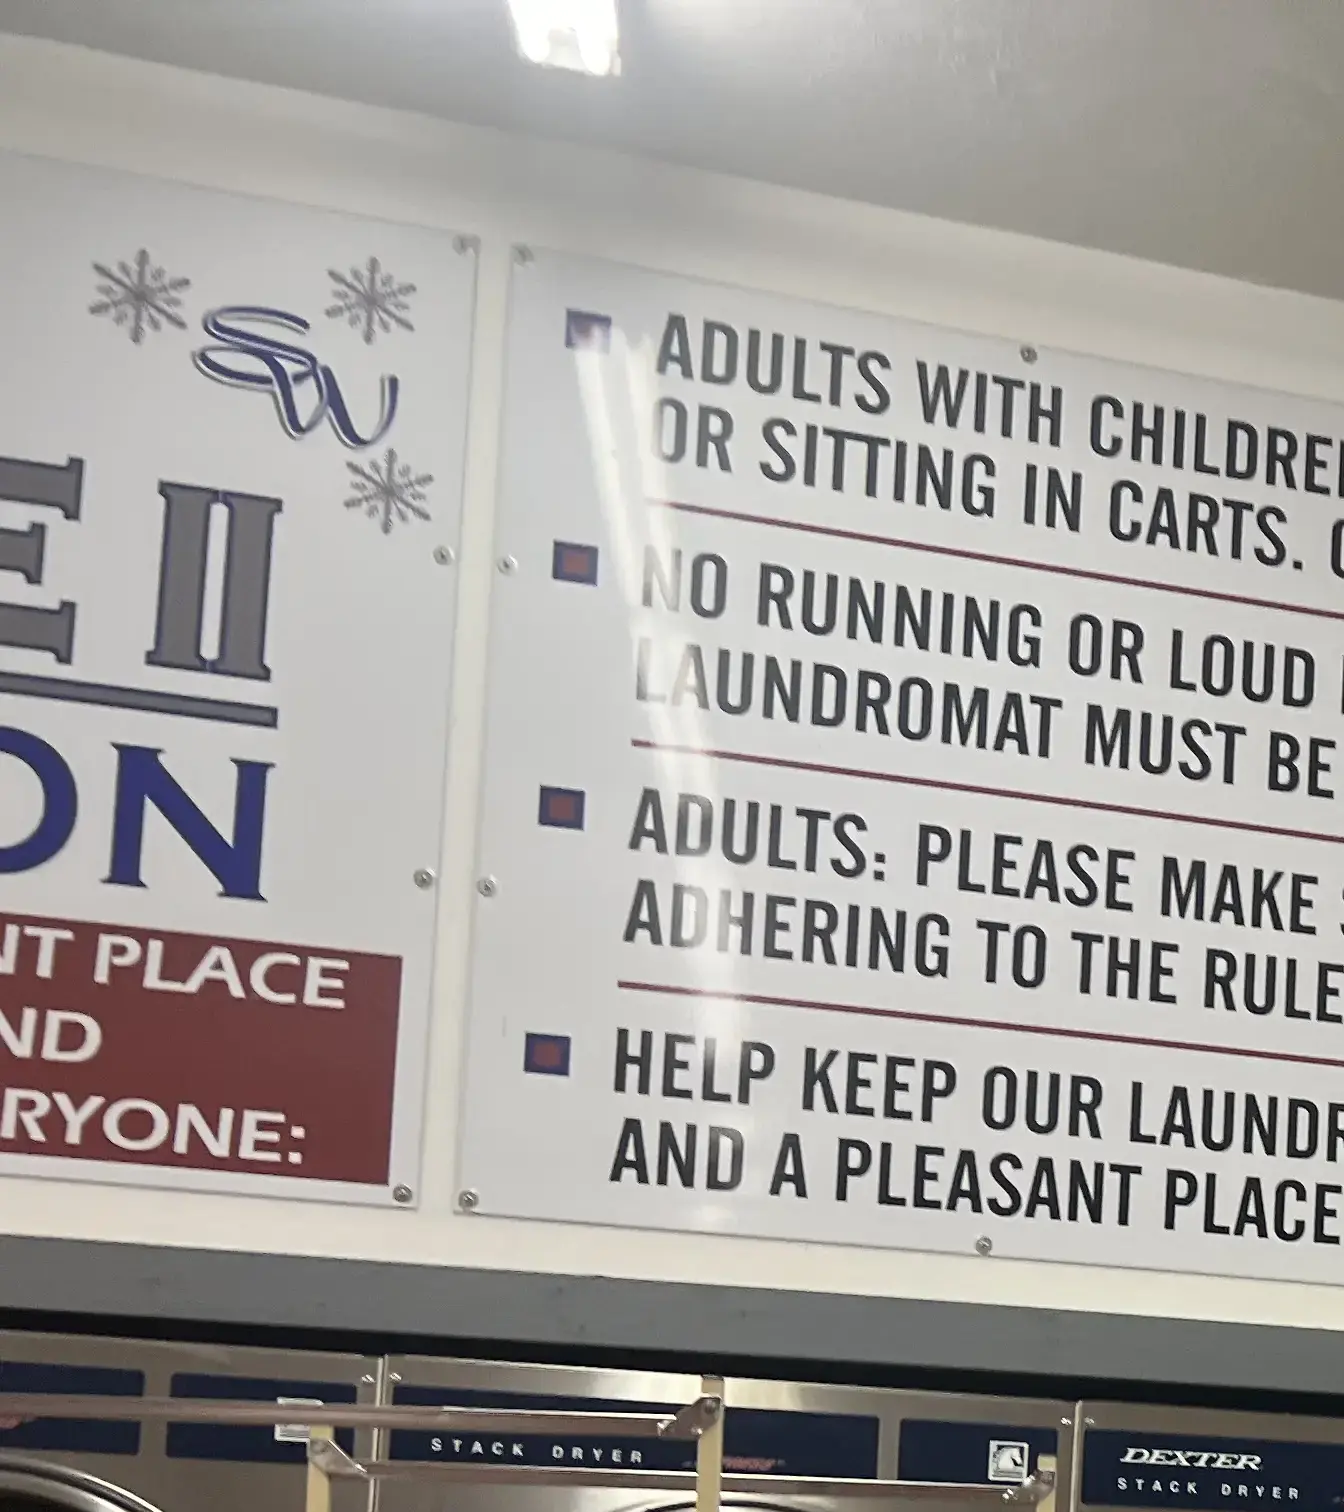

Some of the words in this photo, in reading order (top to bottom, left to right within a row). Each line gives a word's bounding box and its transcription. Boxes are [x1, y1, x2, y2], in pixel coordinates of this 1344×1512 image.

[655, 312, 892, 416] ADULTS
[915, 359, 1063, 449] WITH
[656, 396, 734, 474] OR
[758, 416, 997, 519] SITTING
[1023, 462, 1083, 534] IN
[1108, 479, 1304, 572] CARTS.
[641, 546, 728, 620] NO
[756, 562, 1043, 669] RUNNING
[1067, 612, 1145, 685] OR
[1169, 628, 1316, 709] LOUD
[635, 635, 1064, 762] LAUNDROMAT
[1084, 702, 1248, 786] MUST
[1267, 729, 1337, 801] BE
[627, 786, 887, 883] ADULTS:
[916, 823, 1136, 913] PLEASE
[1160, 855, 1319, 936] MAKE
[94, 932, 351, 1009] PLACE
[622, 878, 951, 979] ADHERING
[975, 918, 1048, 990] TO
[1070, 930, 1180, 1005] THE
[613, 1027, 776, 1106] HELP
[801, 1046, 957, 1124] KEEP
[981, 1065, 1104, 1140] OUR
[608, 1116, 745, 1192] AND
[768, 1131, 809, 1199] A
[835, 1137, 1143, 1227] PLEASANT
[1163, 1167, 1344, 1246] PLACE
[1117, 1477, 1199, 1495] STACK
[1221, 1483, 1300, 1500] DRYER
[1119, 1447, 1262, 1471] DEXTER
